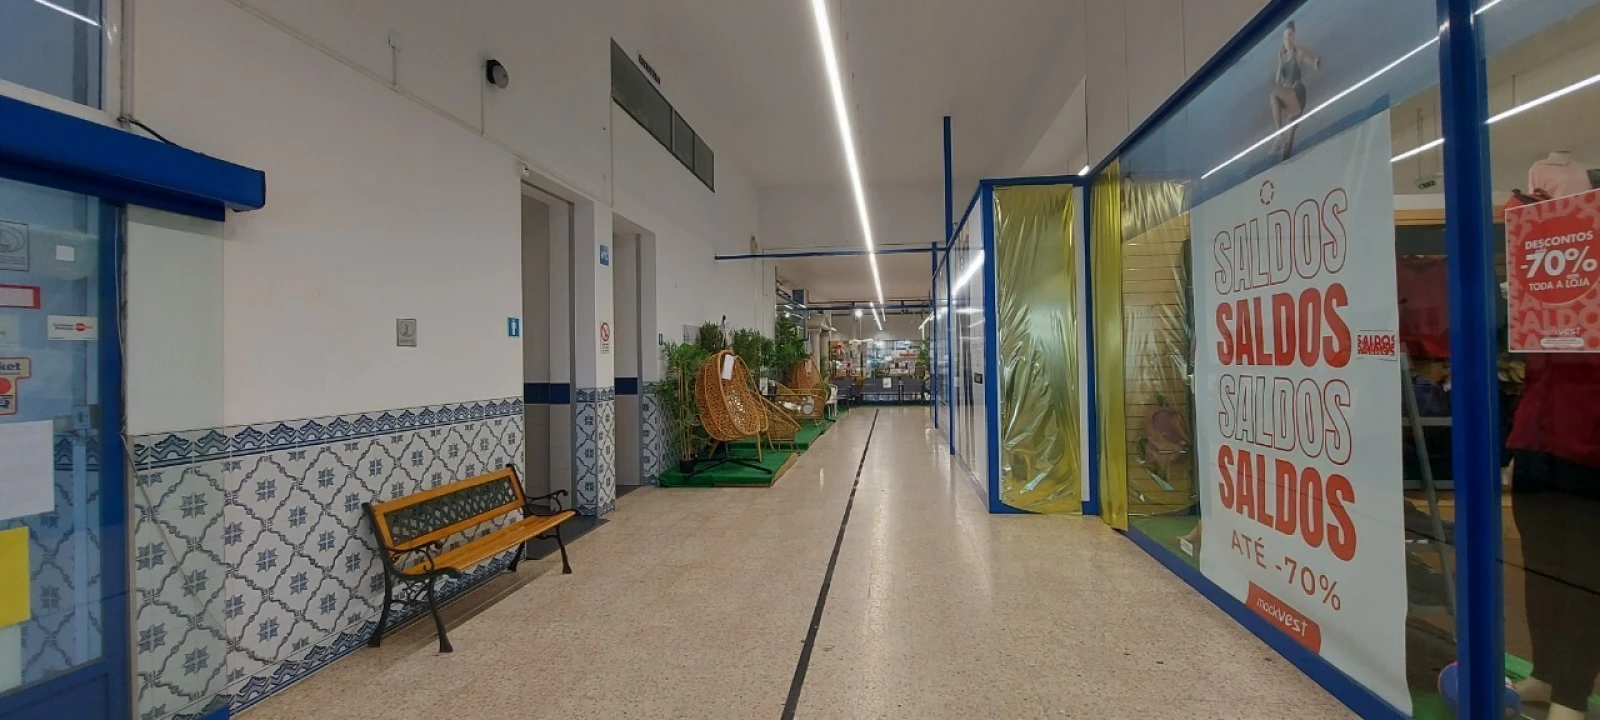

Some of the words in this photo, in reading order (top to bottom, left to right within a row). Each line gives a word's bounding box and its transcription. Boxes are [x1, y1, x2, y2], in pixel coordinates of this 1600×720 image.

[1213, 187, 1348, 295] SALDOS
[1520, 245, 1598, 278] -70%
[1524, 230, 1594, 250] DESCONTOS
[1215, 283, 1352, 368] SALDOS
[1528, 281, 1554, 291] TODA
[1555, 280, 1564, 289] A
[1565, 278, 1590, 288] LOJA
[1218, 374, 1352, 465] SALDOS
[1217, 444, 1357, 561] SALDOS
[1230, 529, 1267, 570] ATÉ
[1274, 555, 1341, 611] -70%
